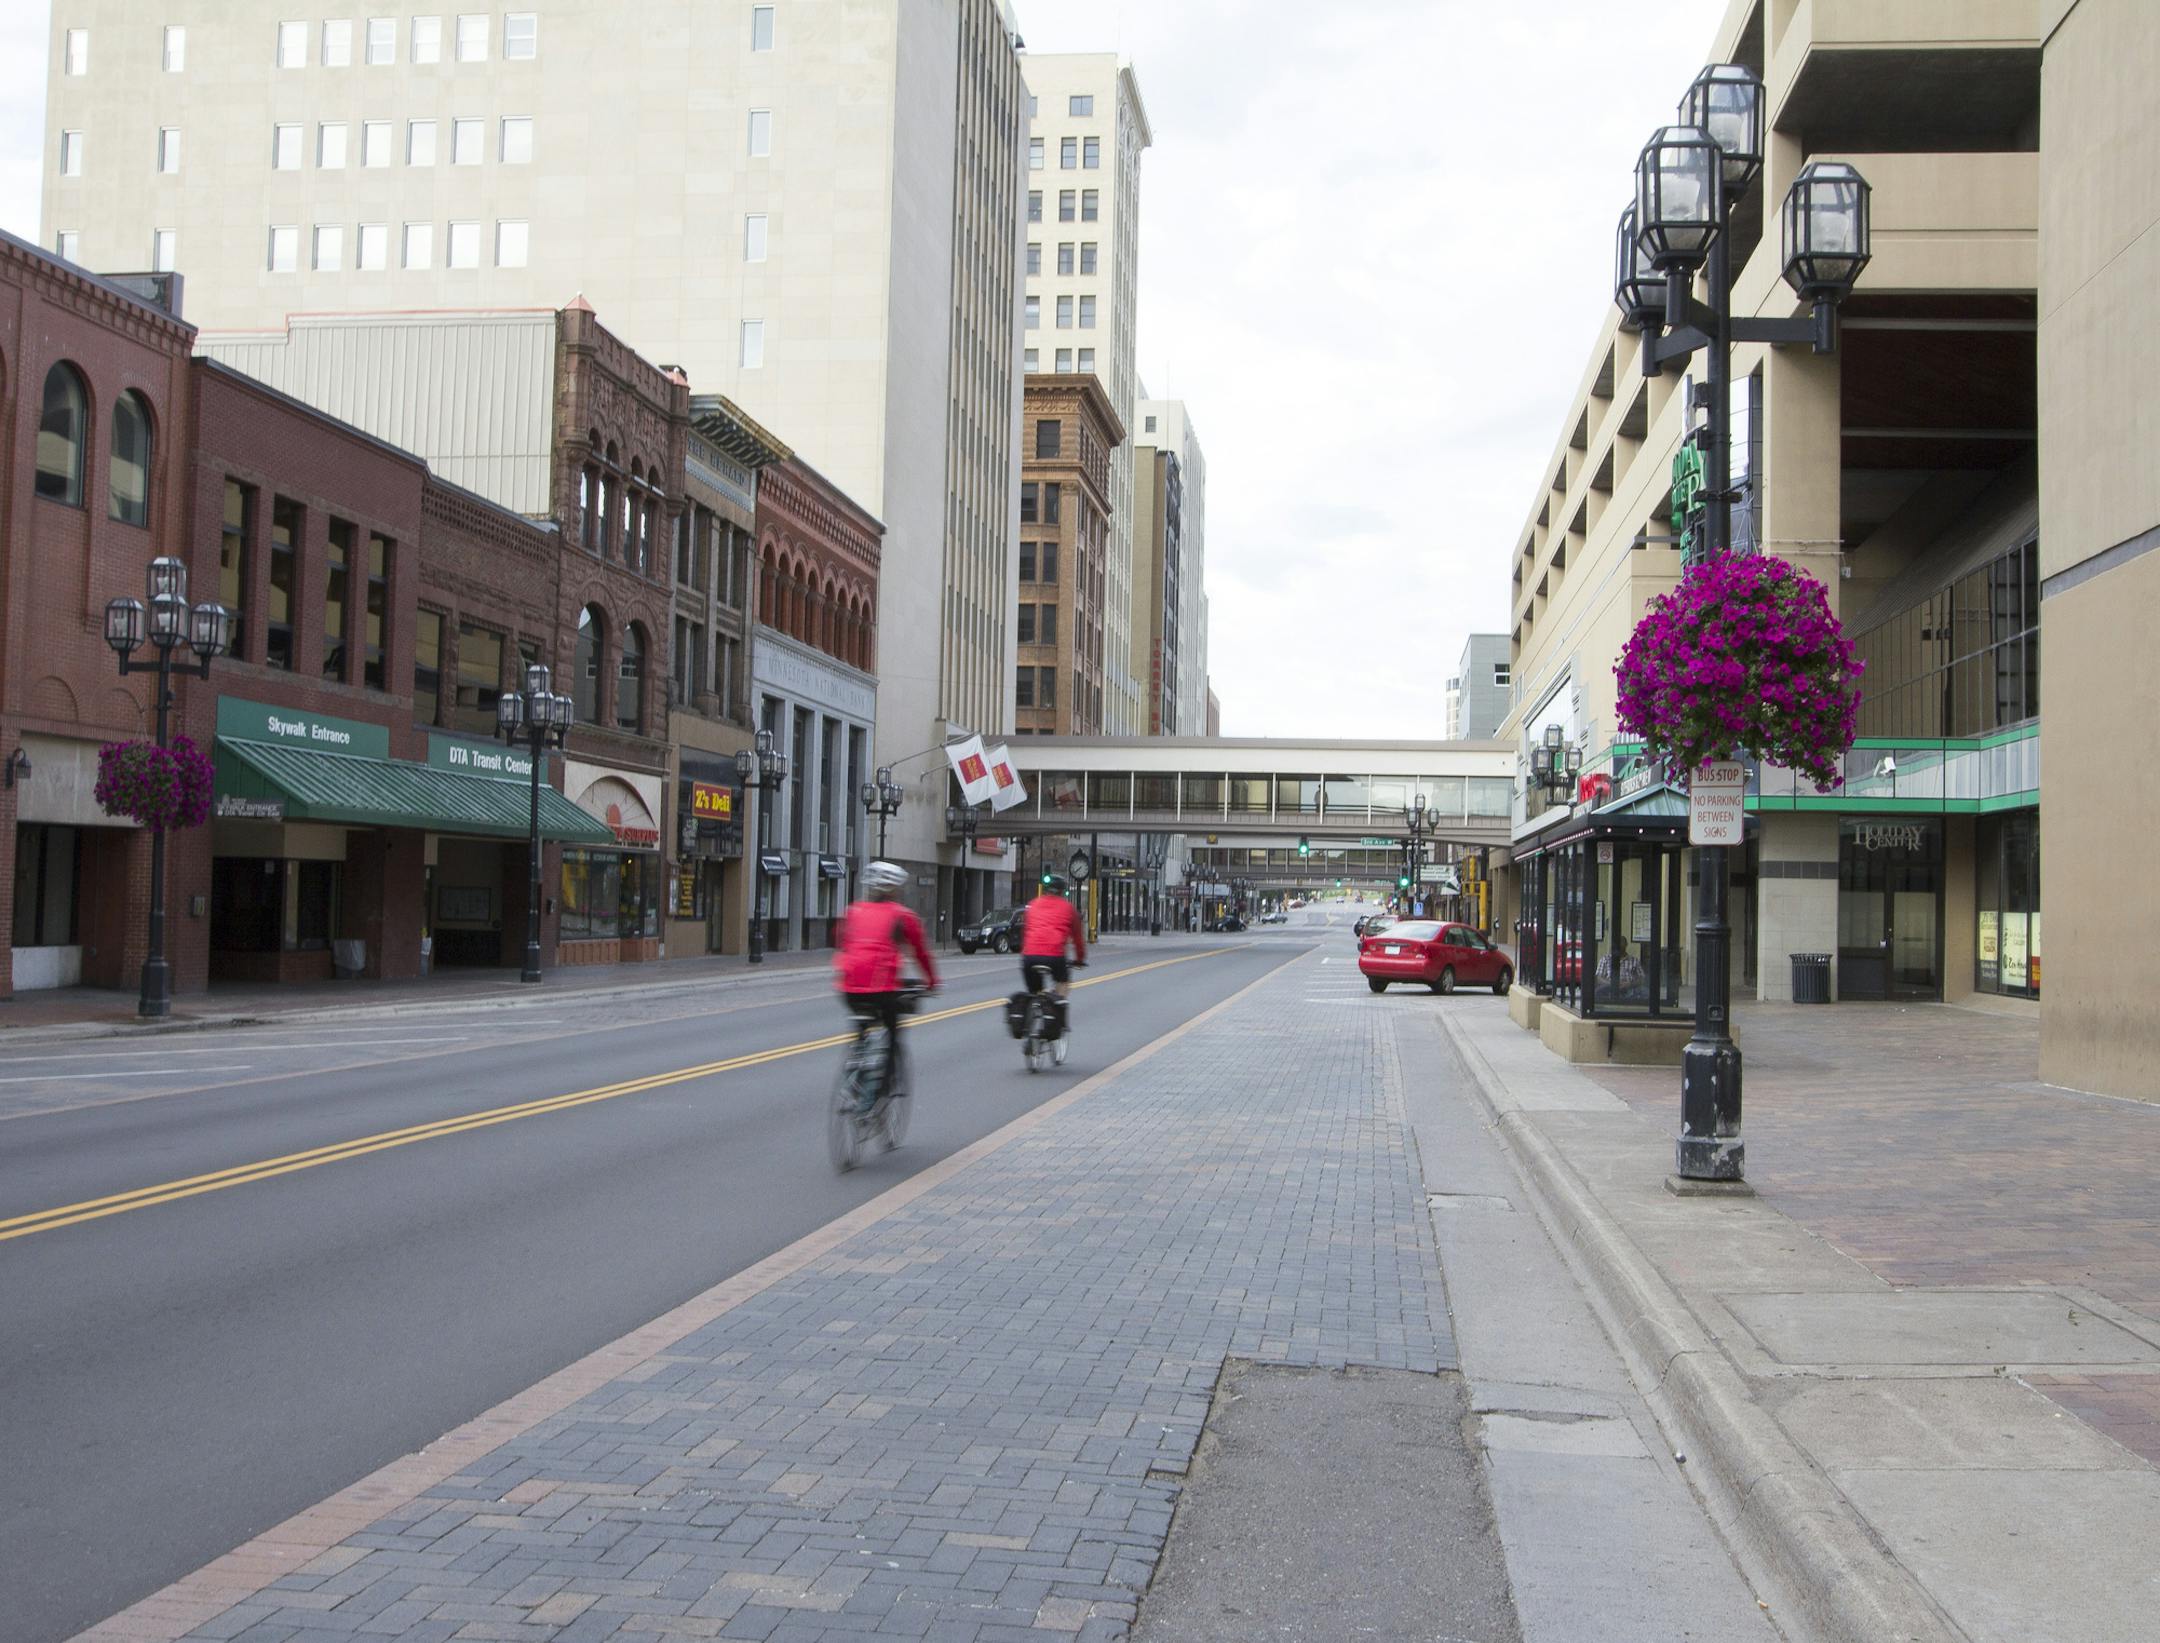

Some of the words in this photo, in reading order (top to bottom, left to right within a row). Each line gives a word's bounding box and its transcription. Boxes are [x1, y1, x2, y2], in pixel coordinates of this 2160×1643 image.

[268, 716, 306, 737] Skywalk
[311, 724, 350, 744] Entrance
[449, 746, 468, 765] DTA
[472, 750, 501, 770] Transit
[505, 756, 533, 775] Center
[1698, 768, 1714, 781] BUS
[1716, 768, 1739, 781] STOP
[695, 790, 709, 809] Z's
[712, 793, 730, 812] Deli
[1695, 795, 1705, 806] NO
[1707, 795, 1740, 806] PARKING
[1697, 811, 1734, 822] BETWEEN
[1704, 827, 1727, 837] SIGNS
[1852, 824, 1925, 845] HOLIDAY
[1865, 837, 1919, 851] CENTER
